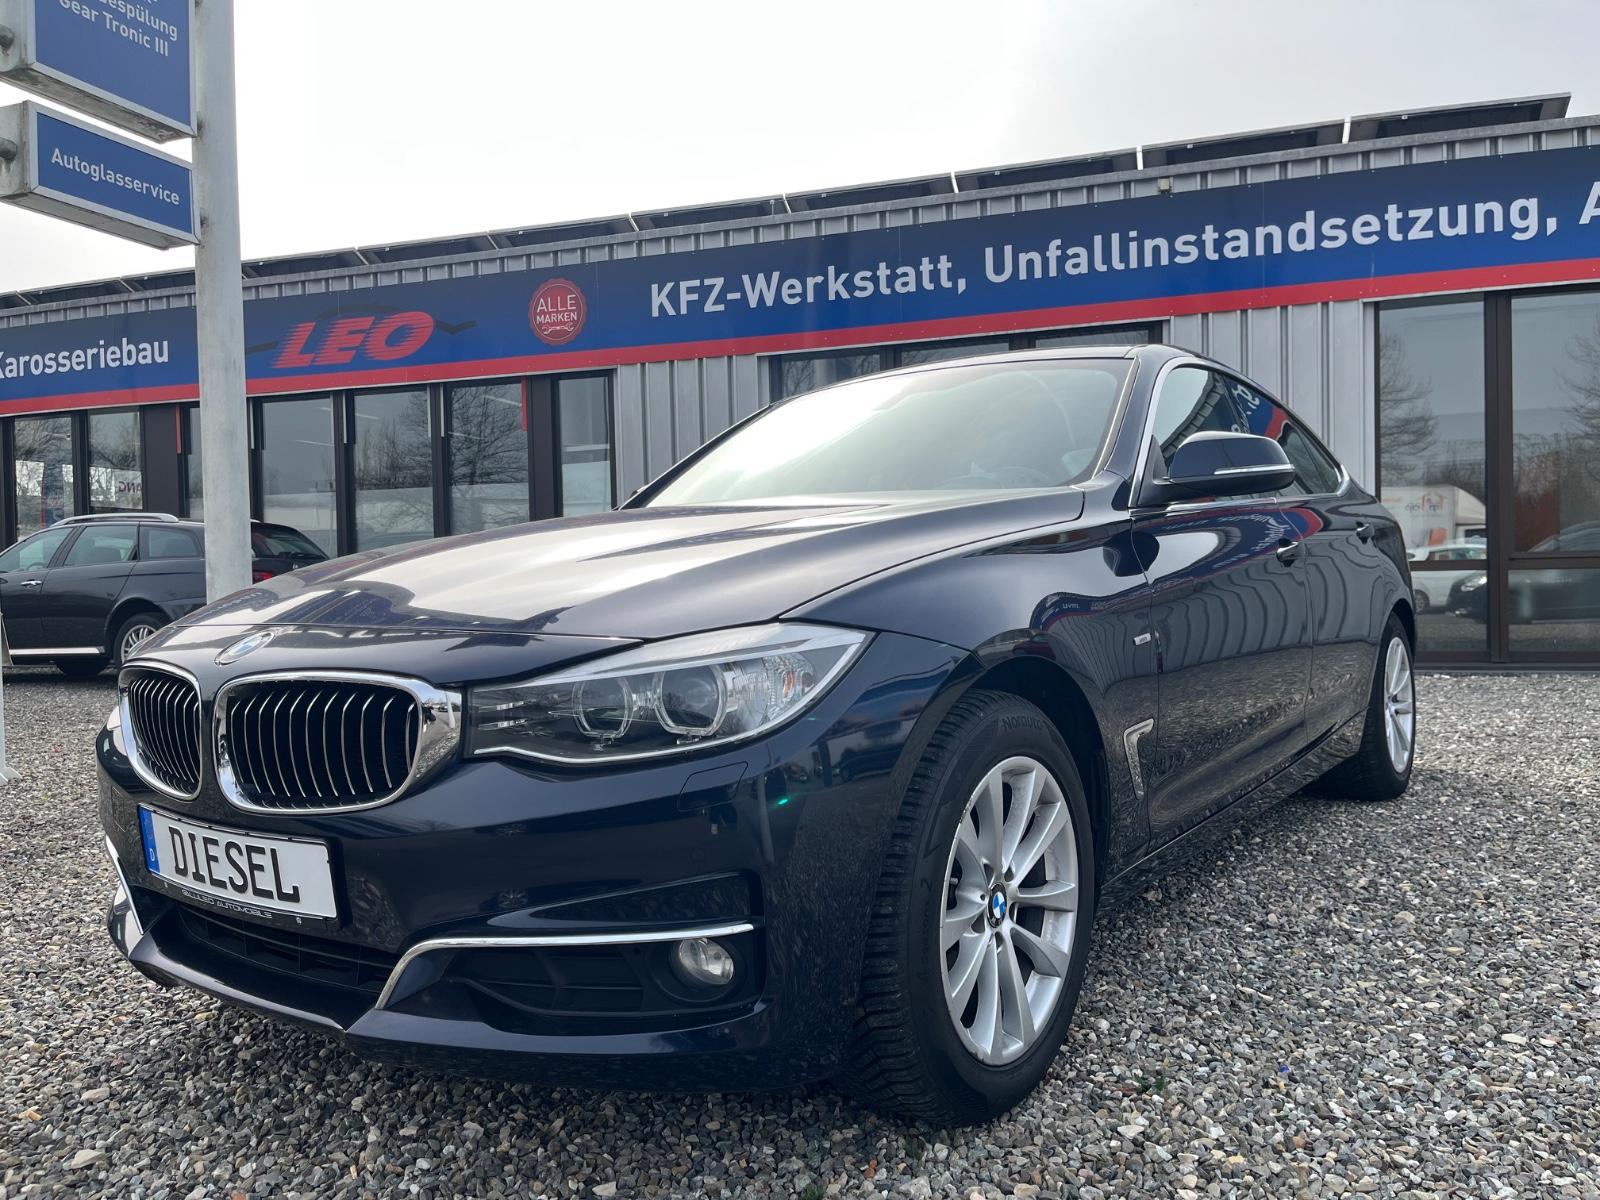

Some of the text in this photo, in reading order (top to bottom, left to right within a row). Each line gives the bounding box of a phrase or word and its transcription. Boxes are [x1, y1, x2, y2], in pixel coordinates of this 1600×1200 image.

[58, 0, 169, 56] Gear Tronic III
[98, 0, 178, 41] espülung
[51, 147, 180, 205] Autoglasservice
[651, 254, 966, 317] KFZ-Werkstatt,
[984, 195, 1558, 283] Unfallinstandsetzung,
[536, 294, 577, 312] ALLE
[536, 311, 577, 323] MARKEN
[0, 337, 169, 378] arosseriebau
[272, 311, 434, 369] LEO
[168, 826, 301, 903] DIESEL
